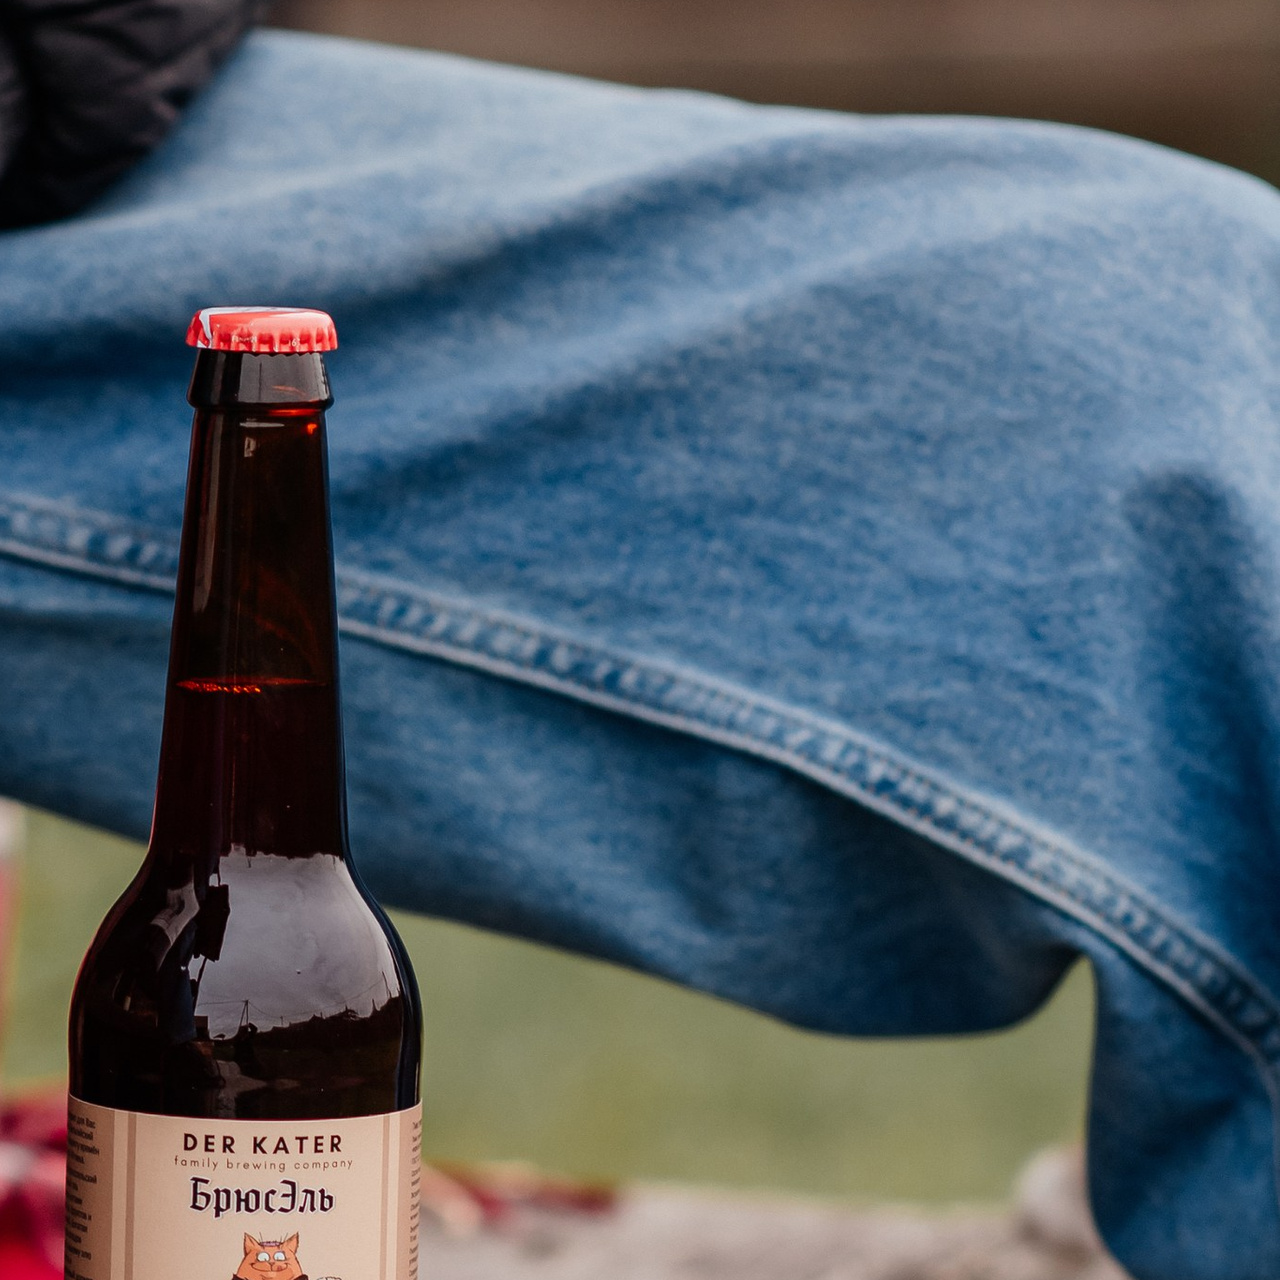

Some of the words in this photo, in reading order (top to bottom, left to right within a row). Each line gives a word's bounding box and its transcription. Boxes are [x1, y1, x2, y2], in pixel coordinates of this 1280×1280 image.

[183, 1133, 236, 1154] DER
[253, 1135, 342, 1155] KATER
[174, 1155, 219, 1171] family
[227, 1158, 286, 1173] brewing
[294, 1160, 353, 1171] company
[189, 1176, 336, 1219] БрюсЭль
